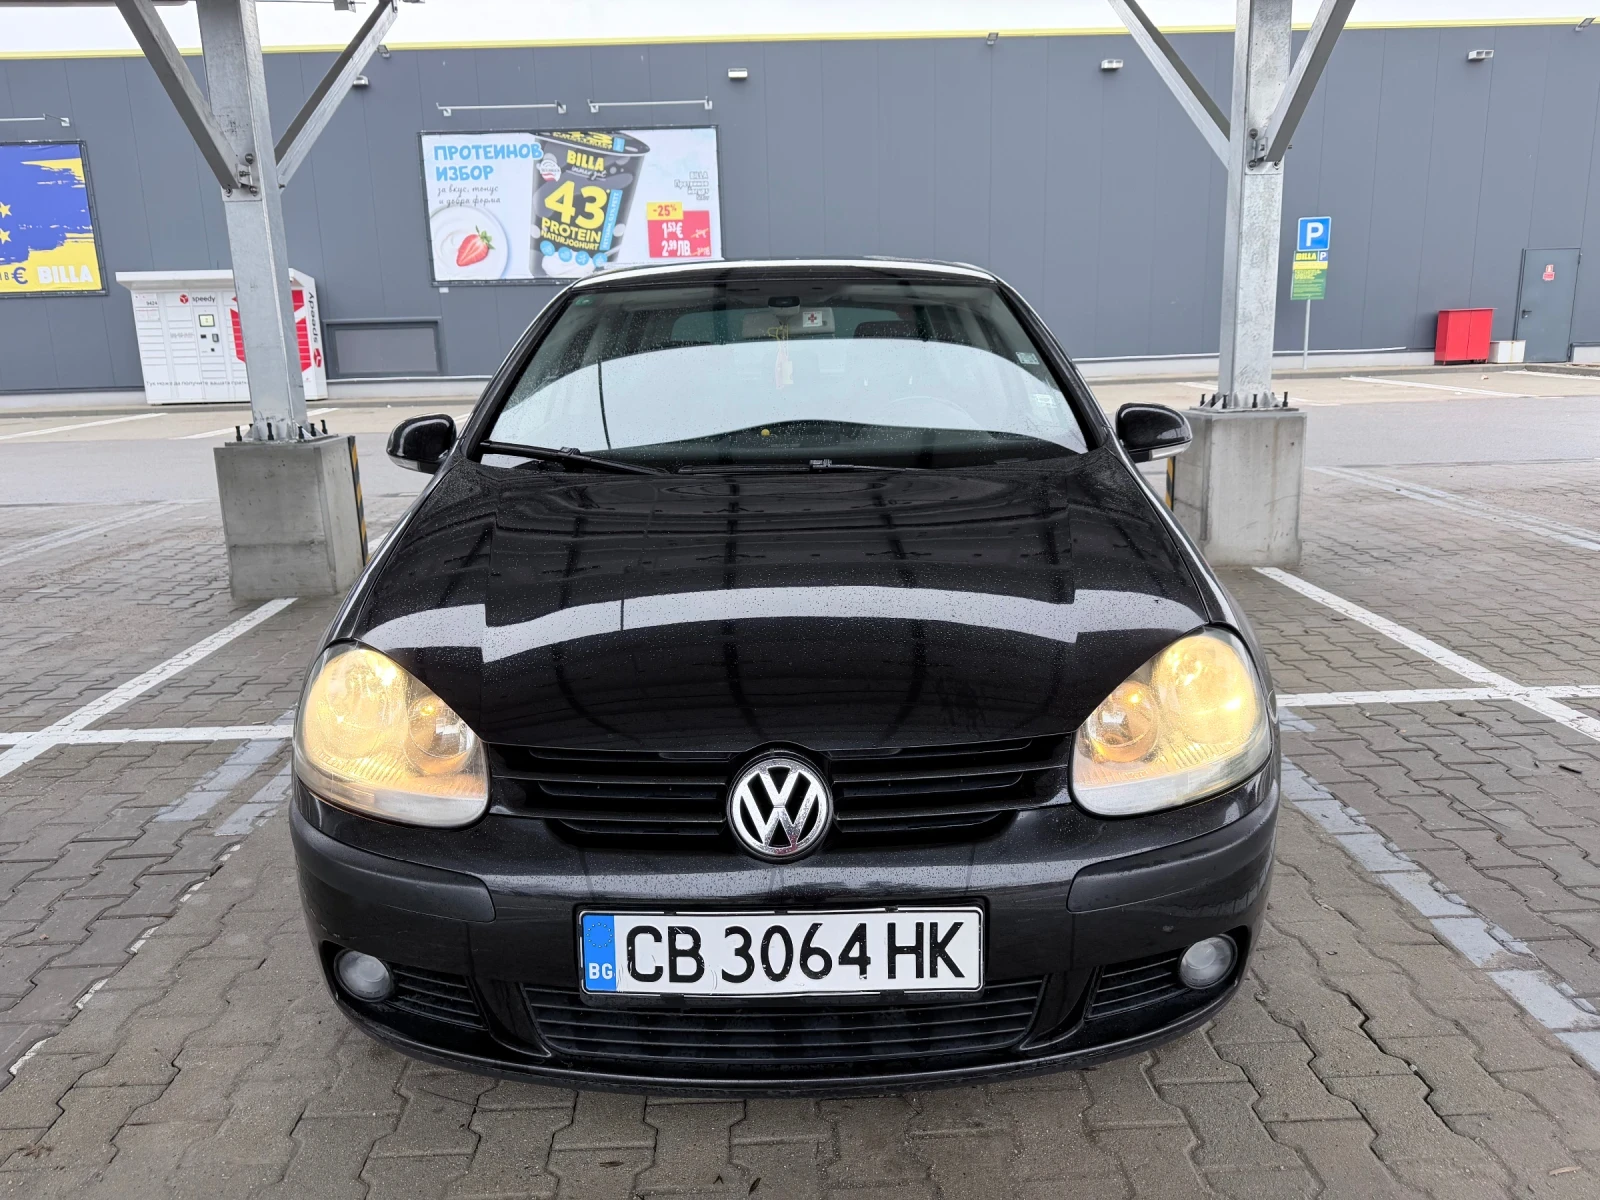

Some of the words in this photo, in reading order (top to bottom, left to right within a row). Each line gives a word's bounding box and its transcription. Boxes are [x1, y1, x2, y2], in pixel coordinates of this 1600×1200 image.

[433, 143, 543, 160] ПРОТЕИНОВ
[566, 149, 605, 171] BILLA
[435, 165, 494, 181] ИЗБОР
[437, 187, 446, 196] за
[472, 185, 498, 196] тонус
[446, 196, 470, 208] добра
[472, 195, 501, 207] форма
[652, 204, 677, 217] -25%
[541, 216, 601, 243] PROTEIN
[1305, 222, 1324, 247] P
[541, 230, 600, 250] NATURJOGHURT
[1319, 251, 1327, 261] P
[37, 264, 94, 284] BILLA
[191, 295, 216, 303] speedy
[308, 291, 318, 343] speedy
[625, 924, 705, 984] CB
[721, 922, 871, 983] 3064
[886, 920, 966, 980] HK
[588, 962, 613, 980] BG
